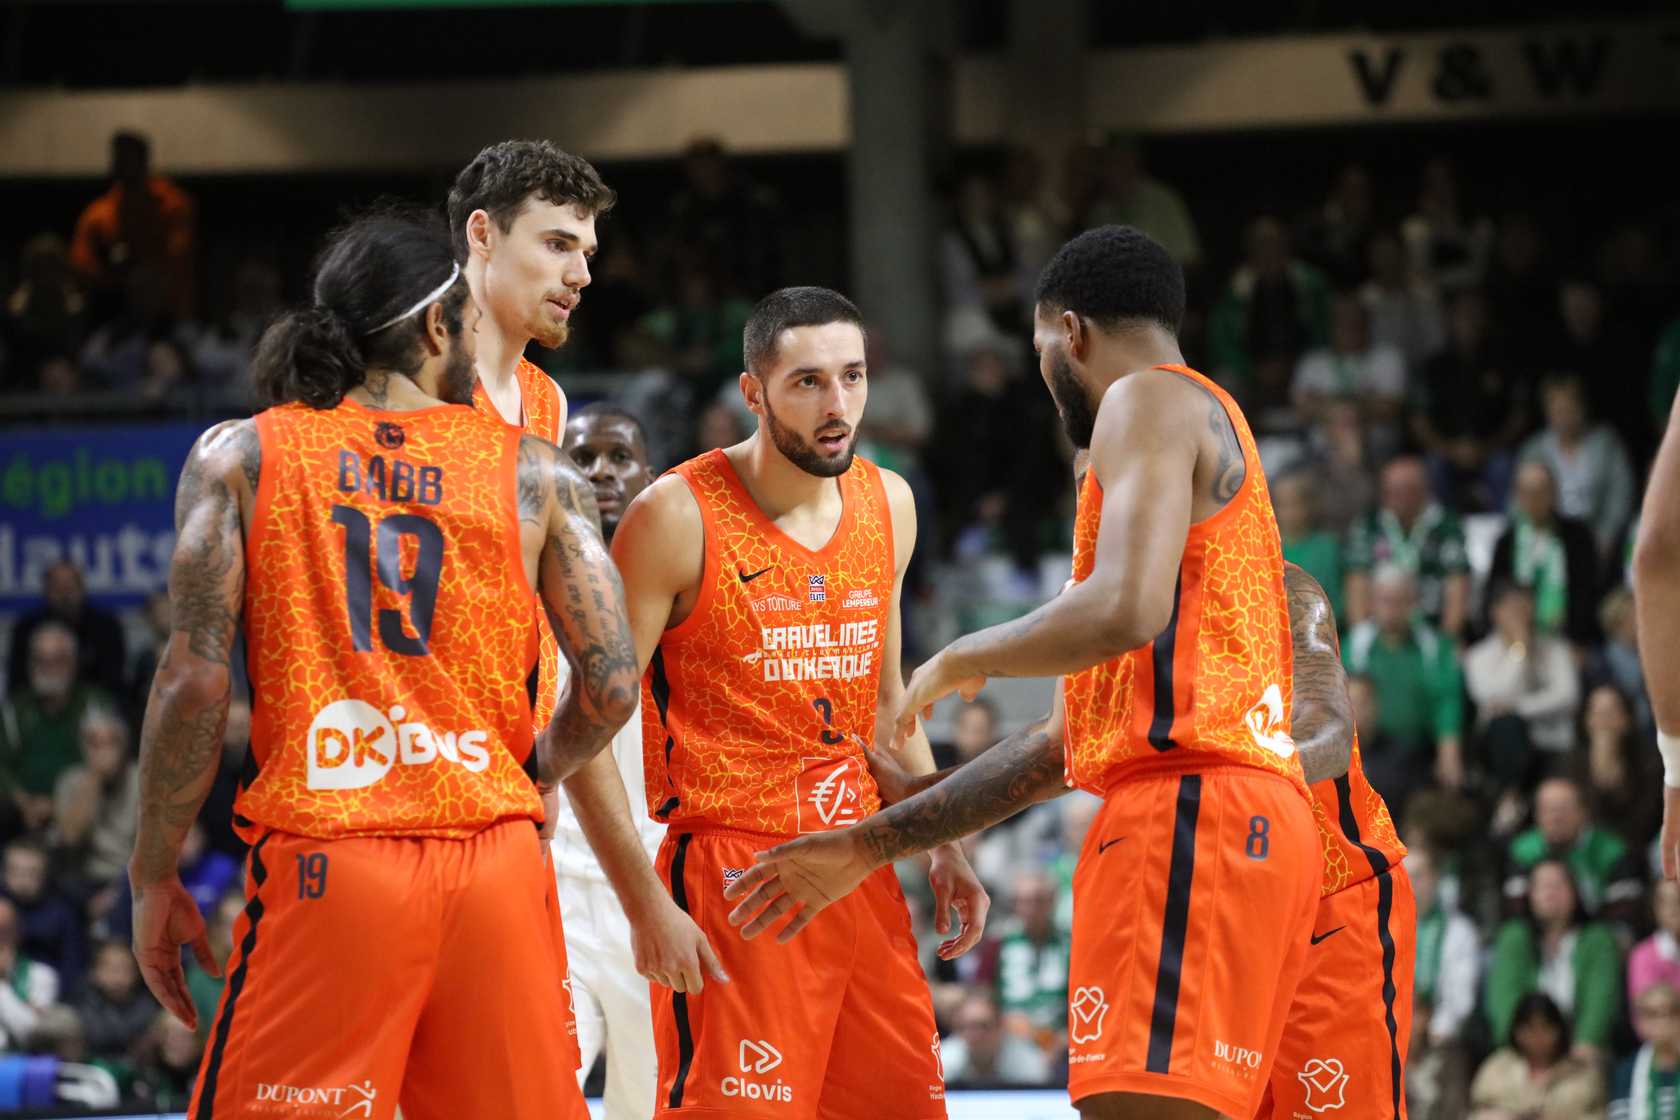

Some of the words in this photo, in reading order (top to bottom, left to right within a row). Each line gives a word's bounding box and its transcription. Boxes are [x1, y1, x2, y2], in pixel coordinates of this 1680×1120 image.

[338, 448, 443, 505] BABB
[331, 504, 445, 657] 19
[762, 619, 878, 650] GRAVELINES
[1245, 815, 1270, 862] 8
[296, 852, 329, 901] 19
[256, 1083, 348, 1105] DUPONT
[720, 1076, 793, 1103] Clovis
